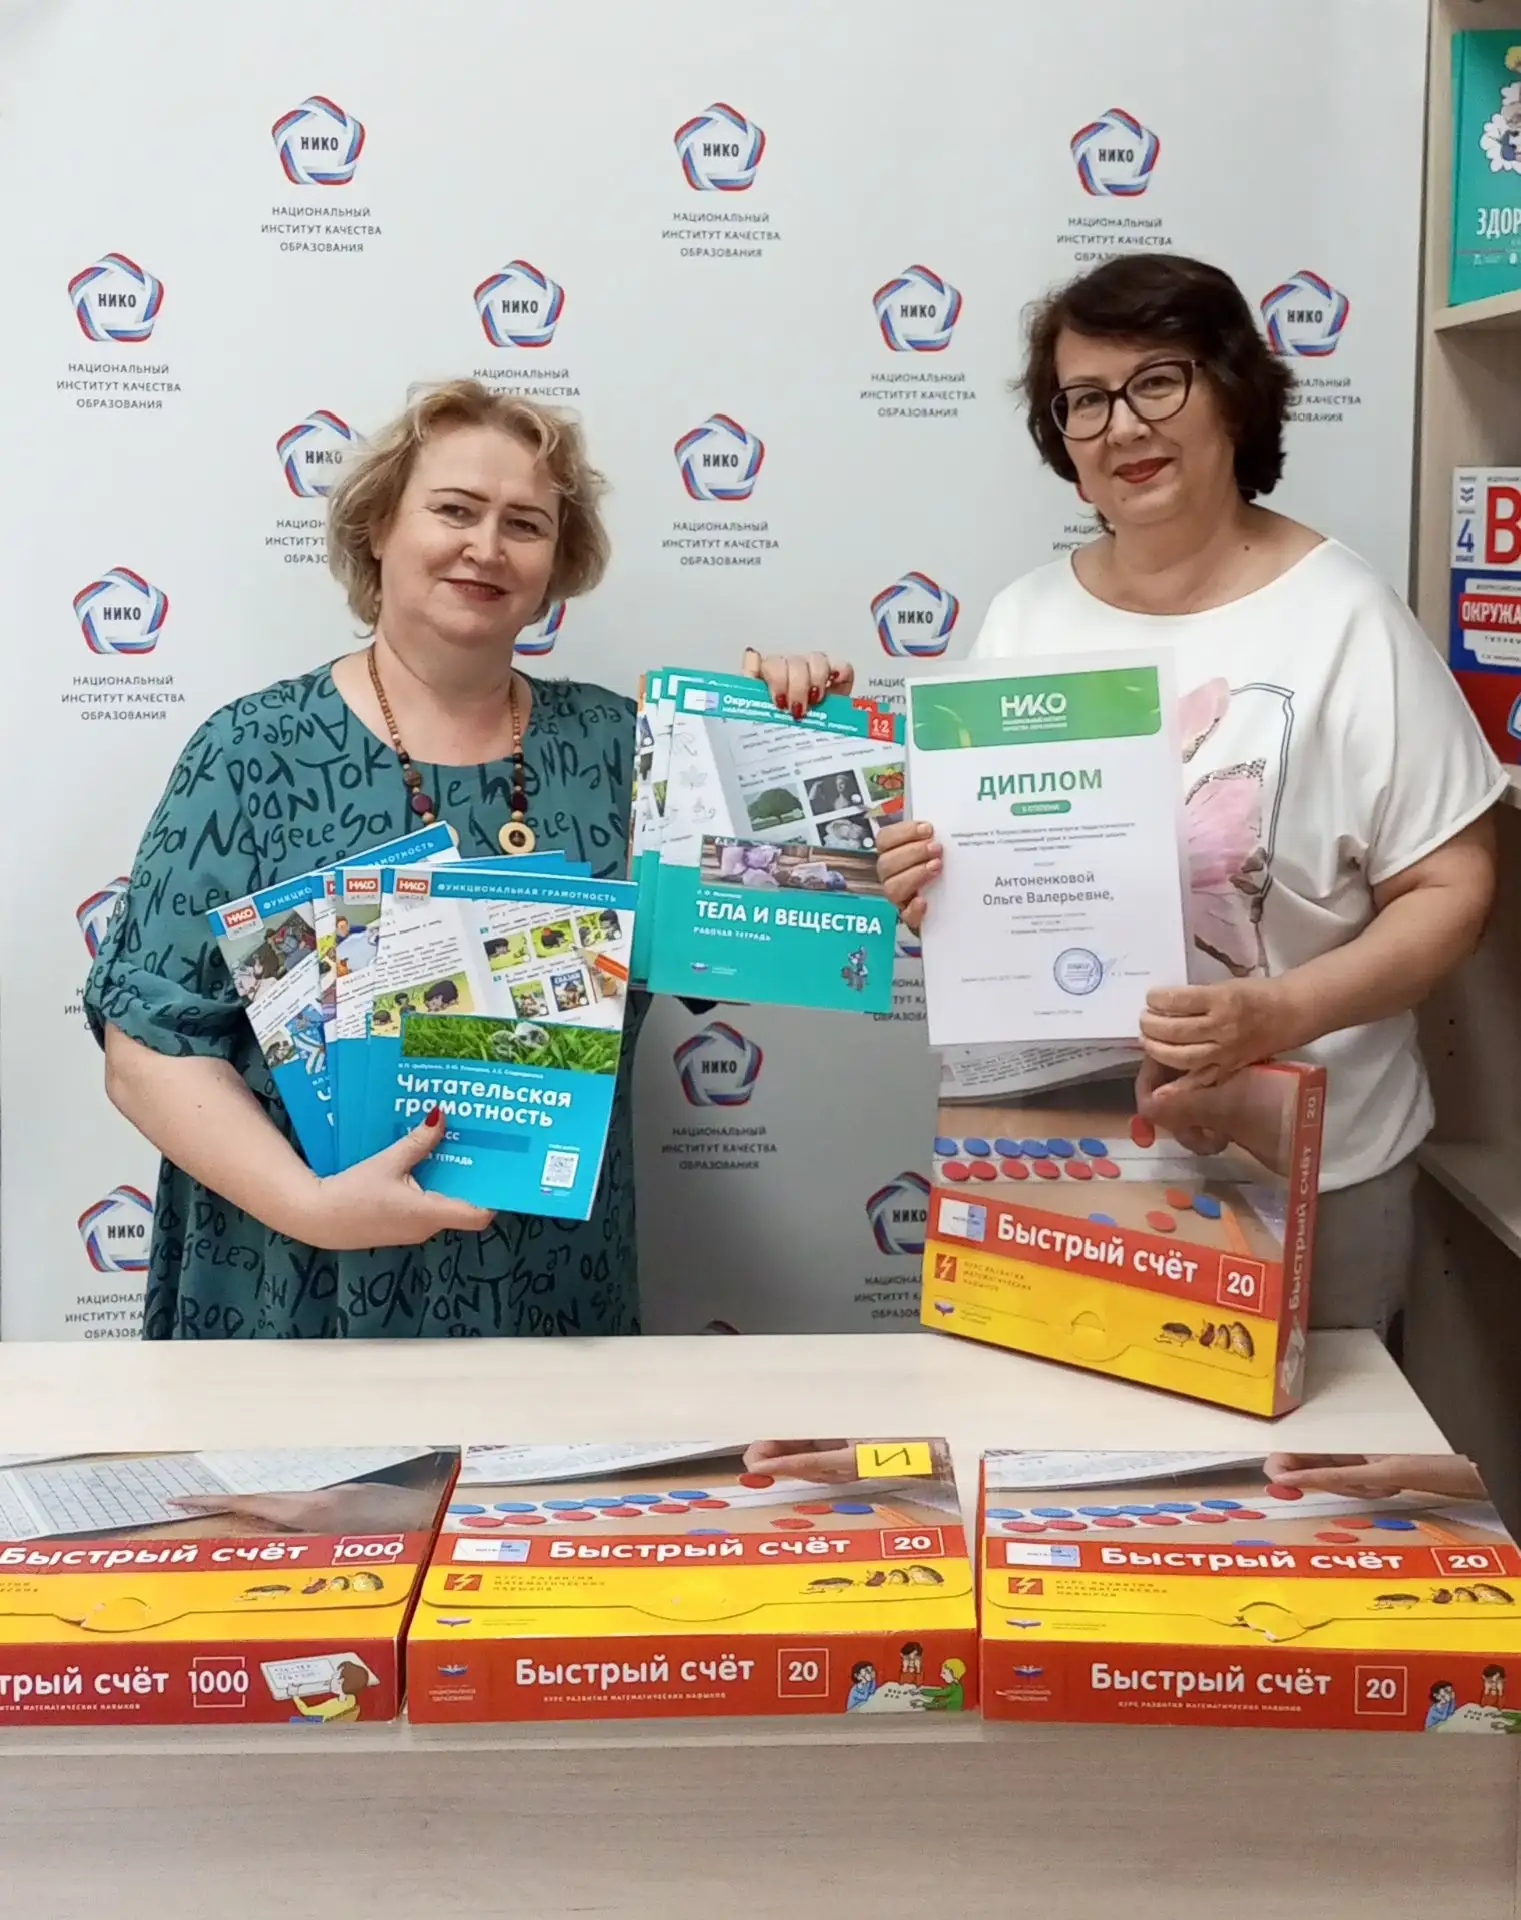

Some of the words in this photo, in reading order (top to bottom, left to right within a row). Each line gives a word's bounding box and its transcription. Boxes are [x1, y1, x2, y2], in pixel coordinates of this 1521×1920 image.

[301, 137, 338, 150] НИКО
[703, 144, 739, 157] НИКО
[1099, 149, 1134, 162] НИКО
[272, 207, 370, 217] НАЦИОНАЛЬНЫЙ
[674, 213, 769, 222] НАЦИОНАЛЬНЫЙ
[261, 224, 321, 233] ИНСТИТУТ
[325, 226, 381, 235] КАЧЕСТВА
[1068, 218, 1162, 228] НАЦИОНАЛЬНЫЙ
[662, 230, 721, 239] ИНСТИТУТ
[725, 231, 780, 240] КАЧЕСТВА
[1057, 235, 1114, 244] ИНСТИТУТ
[1118, 236, 1172, 246] КАЧЕСТВА
[280, 242, 363, 252] ОБРАЗОВАНИЯ
[680, 248, 762, 257] ОБРАЗОВАНИЯ
[99, 294, 136, 307] НИКО
[502, 300, 538, 313] НИКО
[901, 305, 936, 318] НИКО
[1288, 310, 1322, 323] НИКО
[69, 364, 169, 374] НАЦИОНАЛЬНЫЙ
[473, 368, 569, 379] НАЦИОНАЛЬНЫЙ
[871, 373, 965, 383] НАЦИОНАЛЬНЫЙ
[57, 381, 118, 390] ИНСТИТУТ
[123, 382, 181, 391] КАЧЕСТВА
[524, 387, 580, 397] КАЧЕСТВА
[860, 390, 917, 399] ИНСТИТУТ
[921, 391, 976, 400] КАЧЕСТВА
[1306, 395, 1361, 406] КАЧЕСТВА
[77, 399, 162, 408] ОБРАЗОВАНИЯ
[878, 408, 958, 417] ОБРАЗОВАНИЯ
[1289, 412, 1343, 422] ЗОВАНИЯ
[306, 449, 342, 464] НИКО
[703, 454, 738, 467] НИКО
[276, 518, 328, 530] НАЦИОН
[673, 522, 768, 532] НАЦИОНАЛЬНЫЙ
[265, 536, 326, 546] ИНСТИТУТ
[1457, 519, 1474, 552] 4
[662, 539, 721, 548] ИНСТИТУТ
[724, 540, 779, 548] КАЧЕСТВА
[284, 553, 329, 564] ОБРАЗО
[680, 556, 761, 565] ОБРАЗОВАНИЯ
[104, 607, 141, 620] НИКО
[898, 611, 933, 624] НИКО
[73, 675, 173, 685] НАЦИОНАЛЬНЫЙ
[62, 694, 123, 703] ИНСТИТУТ
[127, 693, 185, 702] КАЧЕСТВА
[1000, 692, 1067, 717] НИКО
[81, 711, 166, 720] ОБРАЗОВАНИЯ
[977, 769, 1103, 801] ДИПЛОМ
[348, 878, 376, 892] НИКО
[994, 870, 1095, 888] Антоненковой
[399, 879, 426, 894] НИКО
[438, 884, 538, 896] ФУНКЦИОНАЛЬНАЯ
[542, 888, 617, 903] ГРАМОТНОСТЬ
[983, 892, 1023, 906] Ольге
[1027, 888, 1114, 908] Валерьевне,
[227, 908, 254, 926] НИКО
[696, 900, 747, 922] ТЕЛА
[753, 906, 769, 924] И
[775, 908, 882, 936] ВЕЩЕСТВА
[693, 926, 732, 938] РАБОЧАЯ
[735, 930, 772, 941] ТЕТРАДЬ
[873, 1012, 927, 1022] ОБРАЗОВА
[702, 1061, 737, 1074] НИКО
[396, 1074, 572, 1108] Читательская
[394, 1097, 554, 1128] грамотность
[1307, 1096, 1316, 1119] 20
[672, 1126, 766, 1137] НАЦИОНАЛЬНЫЙ
[662, 1144, 720, 1154] ИНСТИТУТ
[723, 1144, 776, 1154] КАЧЕСТВА
[680, 1160, 759, 1170] ОБРАЗОВАНИЯ
[893, 1210, 926, 1222] НИКО
[108, 1225, 144, 1238] НИКО
[1289, 1203, 1308, 1310] Быстрый
[1300, 1146, 1312, 1194] счёт
[998, 1212, 1124, 1267] Быстрый
[1134, 1249, 1198, 1283] счёт
[1227, 1272, 1254, 1297] 20
[77, 1294, 145, 1305] НАЦИОНАЛ
[855, 1292, 910, 1302] ИНСТИТУТ
[65, 1312, 126, 1323] ИНСТИТУТ
[872, 1309, 920, 1319] ОБРАЗОВ
[85, 1330, 144, 1340] ОБРАЗОВА
[334, 1541, 404, 1558] 1000
[894, 1536, 931, 1550] 20
[0, 1544, 199, 1568] Быстрый
[211, 1542, 308, 1562] счёт
[549, 1538, 741, 1562] Быстрый
[758, 1538, 852, 1556] счёт
[1100, 1548, 1296, 1571] Быстрый
[1310, 1550, 1404, 1570] счёт
[1448, 1554, 1489, 1568] 20
[515, 1656, 682, 1694] Быстрый
[694, 1656, 755, 1684] счёт
[789, 1662, 818, 1682] 20
[95, 1669, 170, 1694] счёт
[188, 1671, 248, 1694] 1000
[1091, 1662, 1246, 1696] Быстрый
[1256, 1670, 1332, 1694] счёт
[1366, 1680, 1396, 1699] 20
[610, 1694, 684, 1702] МАТЕМАТИЧЕСКИХ
[1118, 1700, 1139, 1708] КУРС
[1141, 1701, 1184, 1709] РАЗВИТИЯ
[1185, 1702, 1260, 1711] МАТЕМАТИЧЕСКИХ
